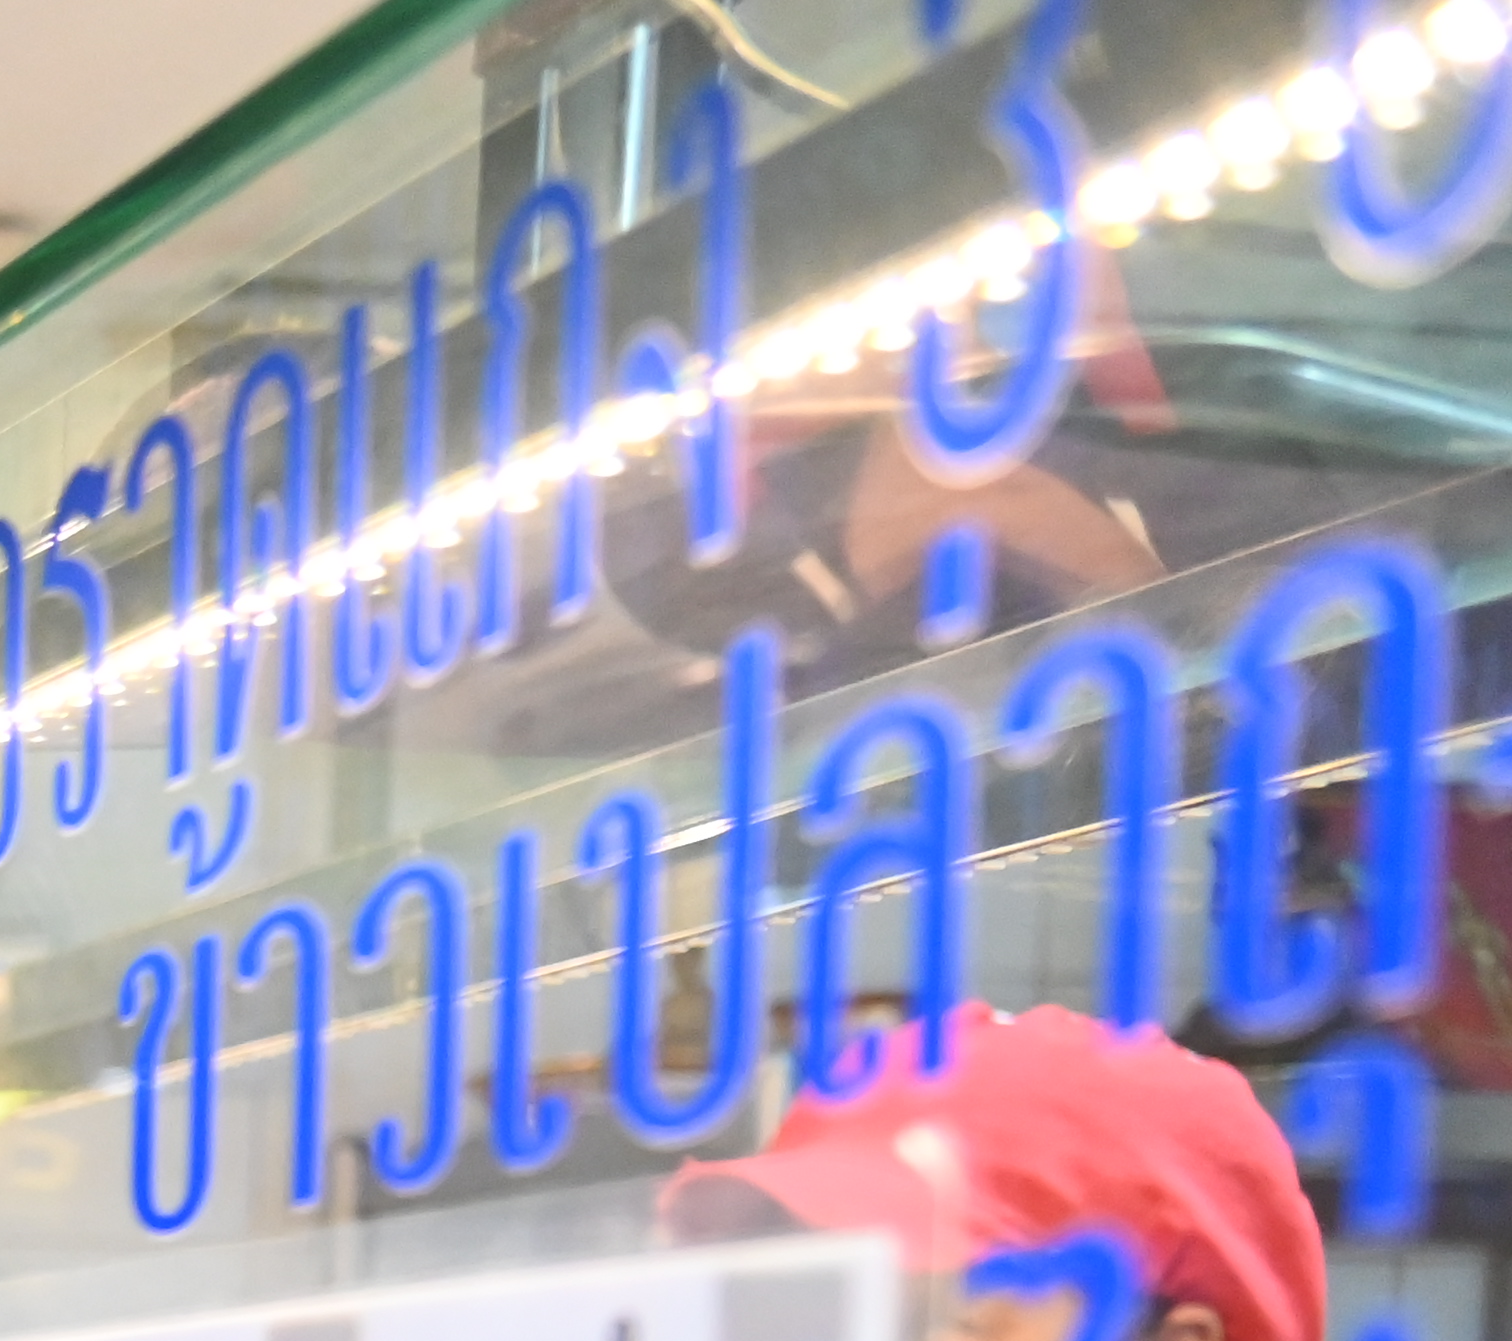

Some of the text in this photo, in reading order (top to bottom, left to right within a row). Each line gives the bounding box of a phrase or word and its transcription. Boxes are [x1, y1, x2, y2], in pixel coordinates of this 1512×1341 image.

[118, 525, 1512, 1240] ข้าวเปล่าถุ
